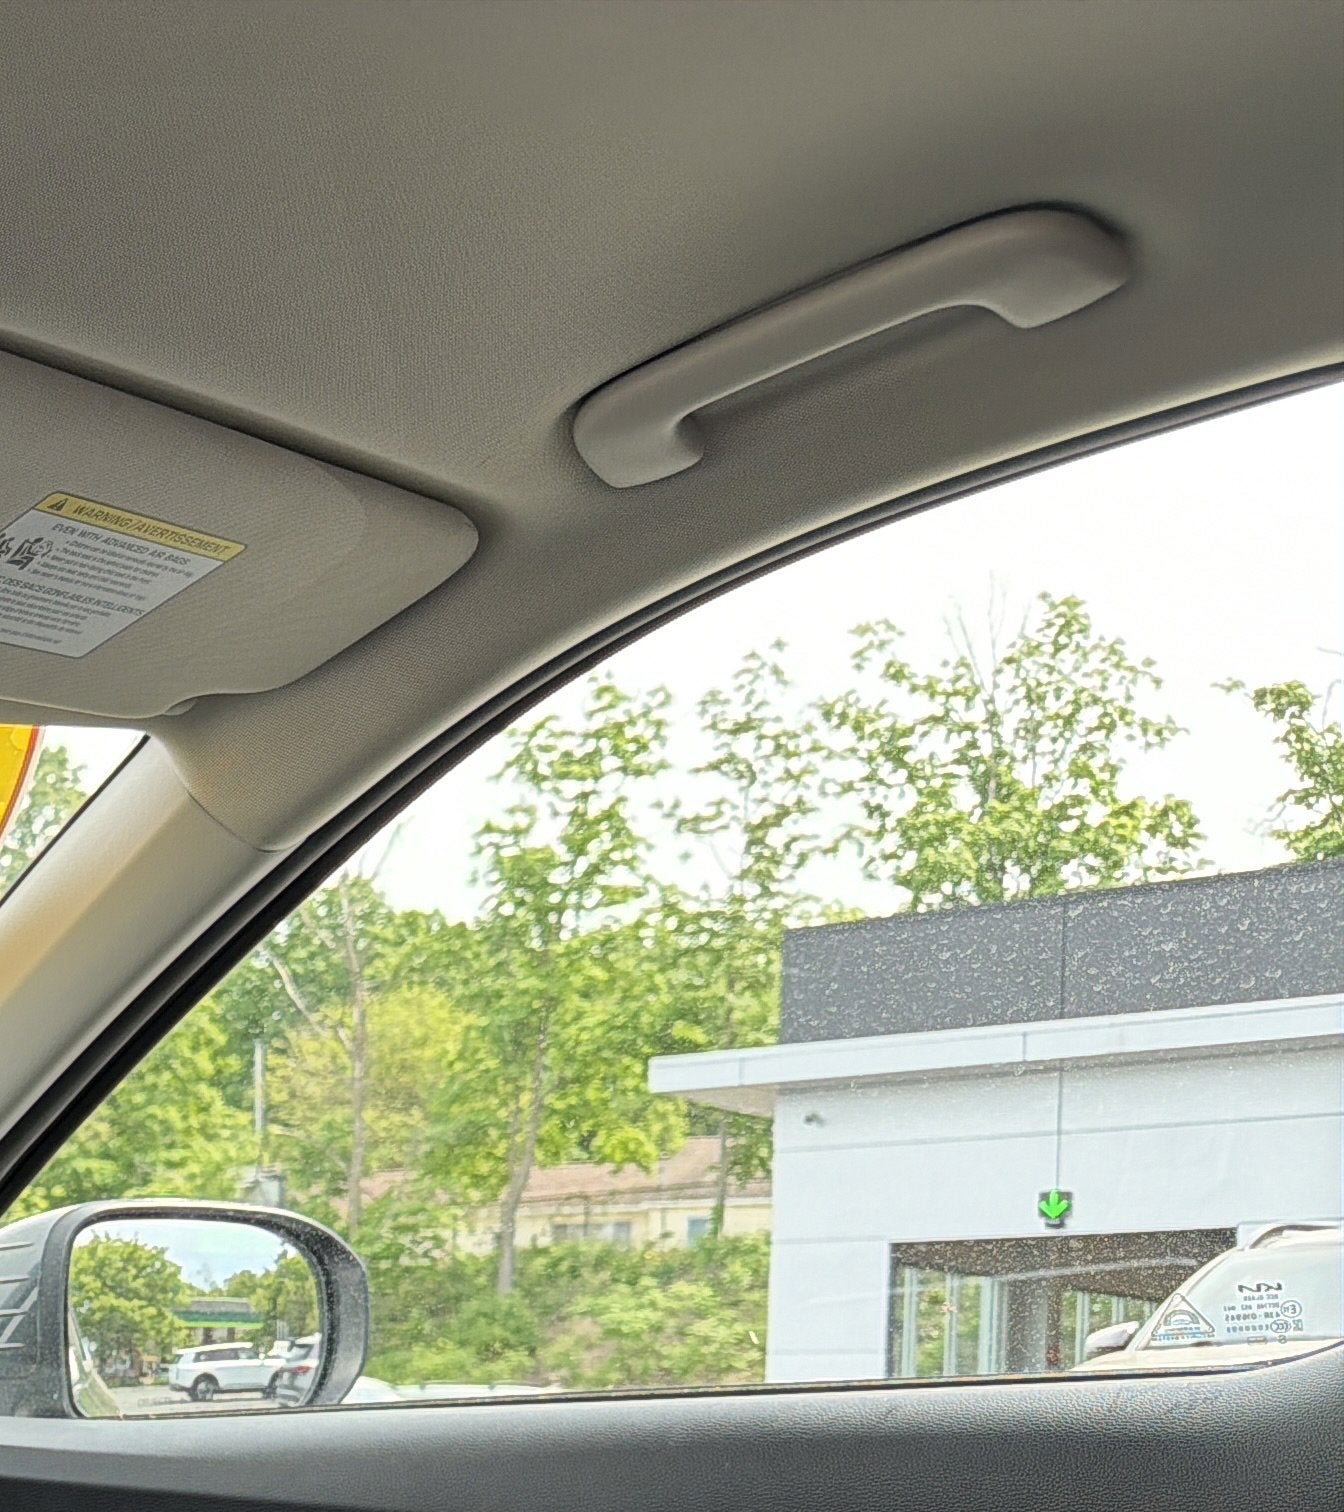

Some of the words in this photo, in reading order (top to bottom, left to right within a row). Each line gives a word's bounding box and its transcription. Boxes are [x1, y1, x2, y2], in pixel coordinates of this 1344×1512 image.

[69, 504, 134, 528] WARNING
[50, 523, 79, 535] EVEN
[75, 530, 103, 542] WITH
[99, 536, 152, 554] ADVANCED
